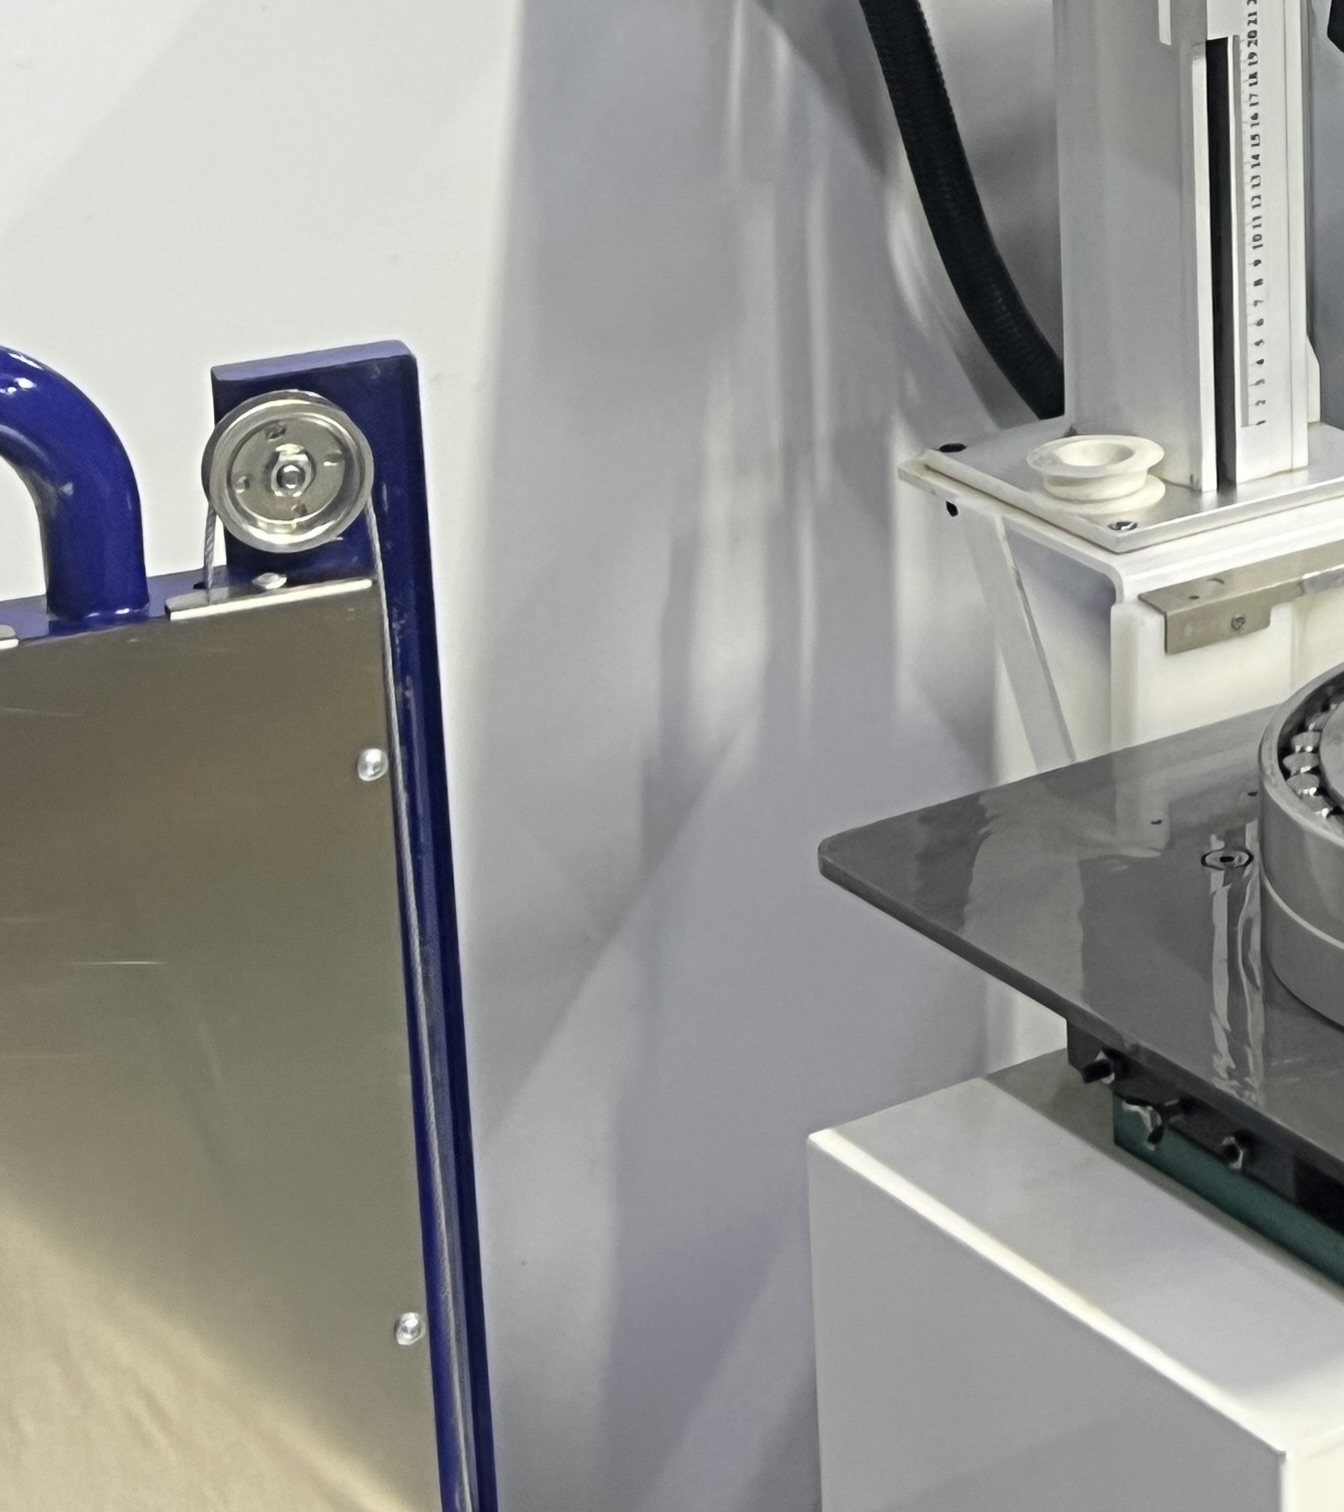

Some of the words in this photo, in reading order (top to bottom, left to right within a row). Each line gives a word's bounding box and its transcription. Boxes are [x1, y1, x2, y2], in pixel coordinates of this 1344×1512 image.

[1248, 12, 1257, 25] 21
[1248, 31, 1258, 47] 20
[1249, 52, 1258, 65] 19
[1250, 94, 1259, 106] 17
[1251, 134, 1260, 147] 15
[1251, 154, 1260, 168] 14
[1252, 216, 1262, 228] 11
[1252, 234, 1262, 249] 10
